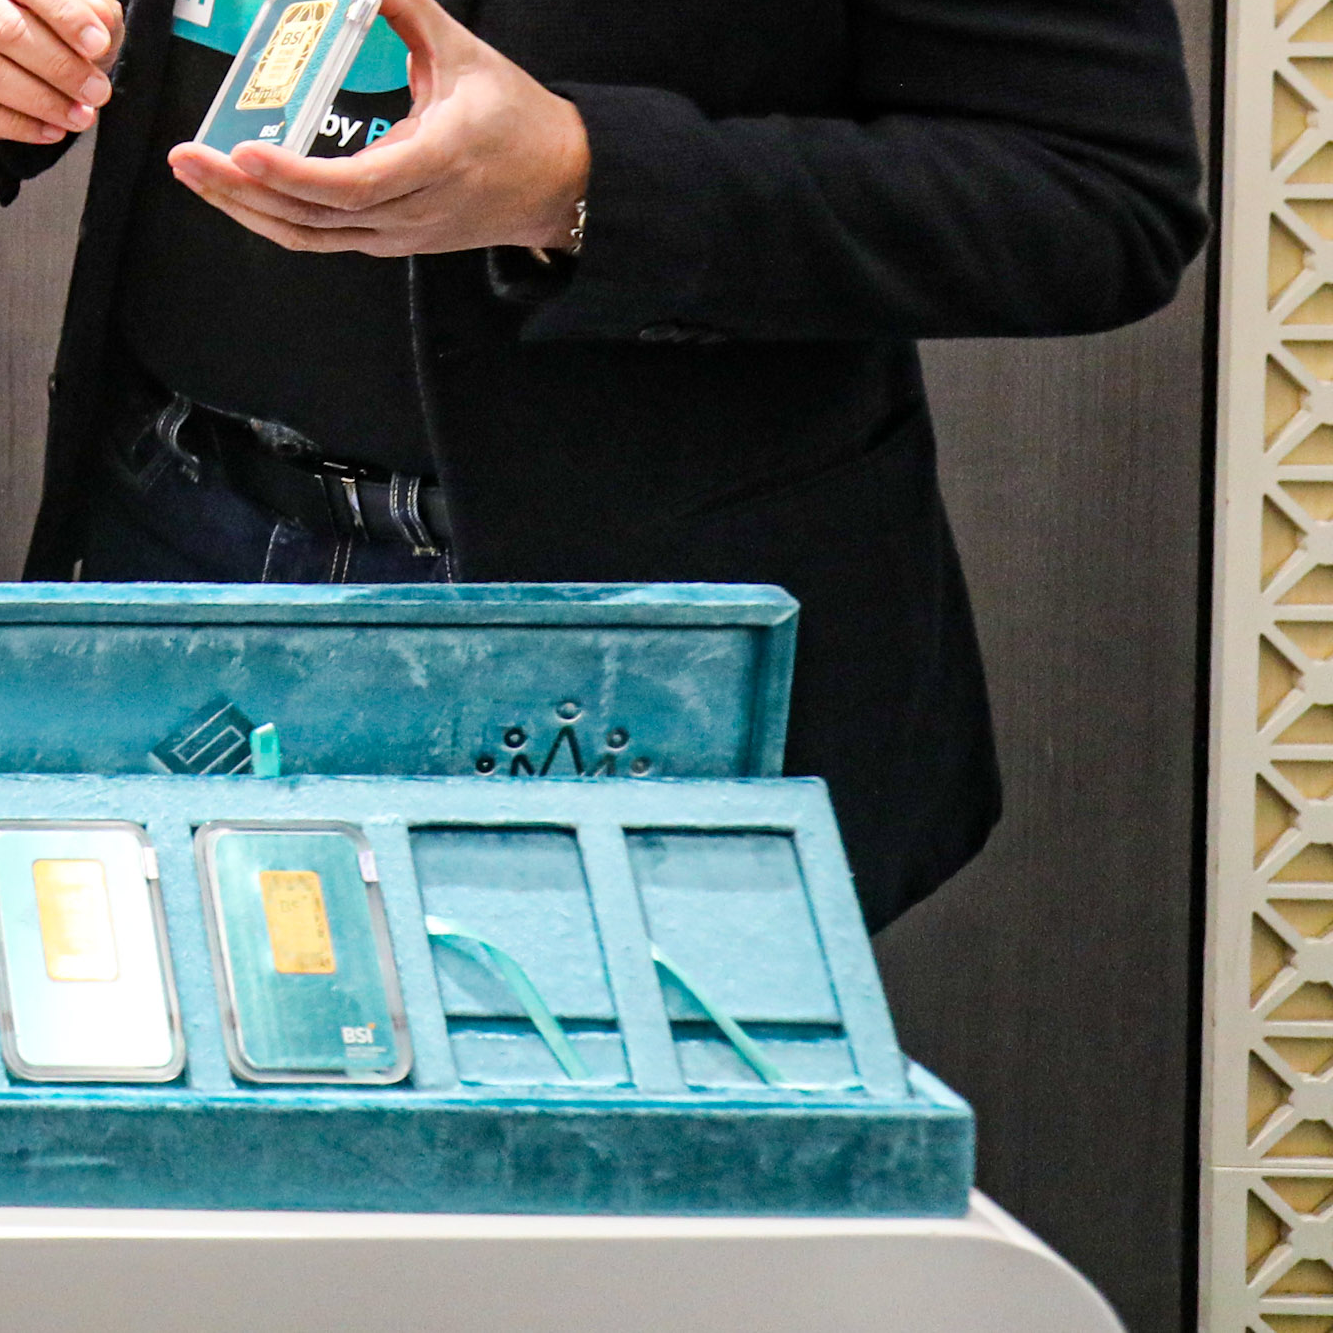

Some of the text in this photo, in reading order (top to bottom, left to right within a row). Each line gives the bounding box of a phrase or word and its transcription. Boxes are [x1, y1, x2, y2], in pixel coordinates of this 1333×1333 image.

[281, 31, 305, 46] BSI
[259, 124, 280, 138] BSI
[318, 105, 363, 147] by
[341, 1026, 375, 1044] BSI
